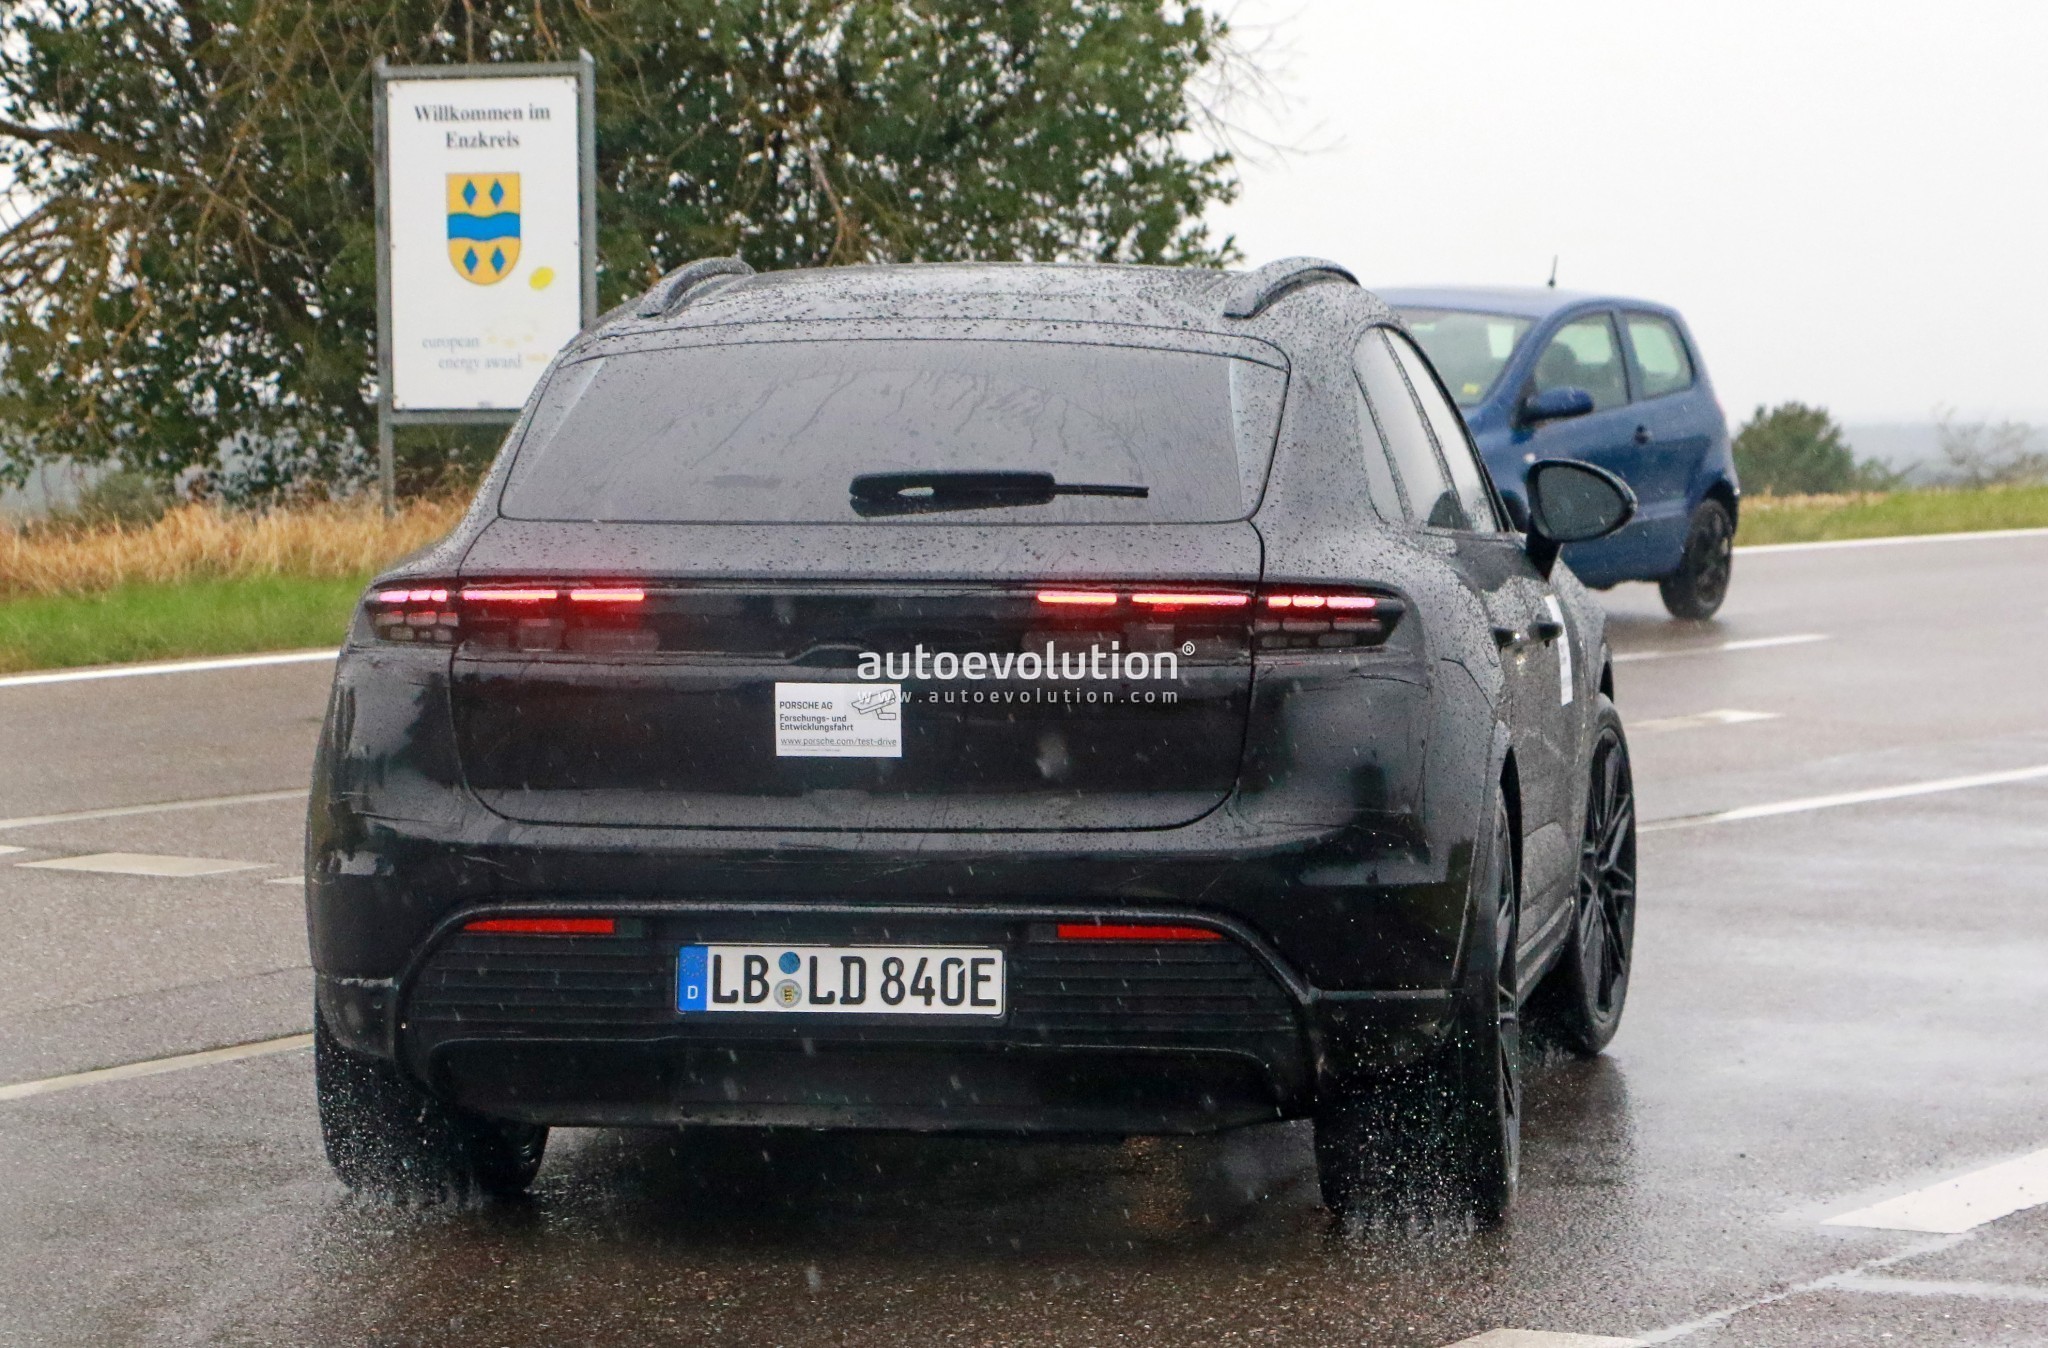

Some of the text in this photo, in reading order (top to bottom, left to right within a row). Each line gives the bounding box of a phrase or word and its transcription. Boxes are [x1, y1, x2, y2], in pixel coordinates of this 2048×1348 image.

[415, 103, 551, 122] Willkommen im
[445, 130, 520, 149] Enzkreis
[422, 337, 480, 353] european
[438, 352, 522, 374] energy award
[779, 701, 833, 710] PORSCHE AG
[779, 714, 830, 724] Forschungs-
[780, 723, 854, 733] Entwicklungsfahrt
[780, 737, 897, 747] www.porsche.com/test-drive
[712, 954, 997, 1006] LB LD 840E
[687, 985, 698, 999] D
